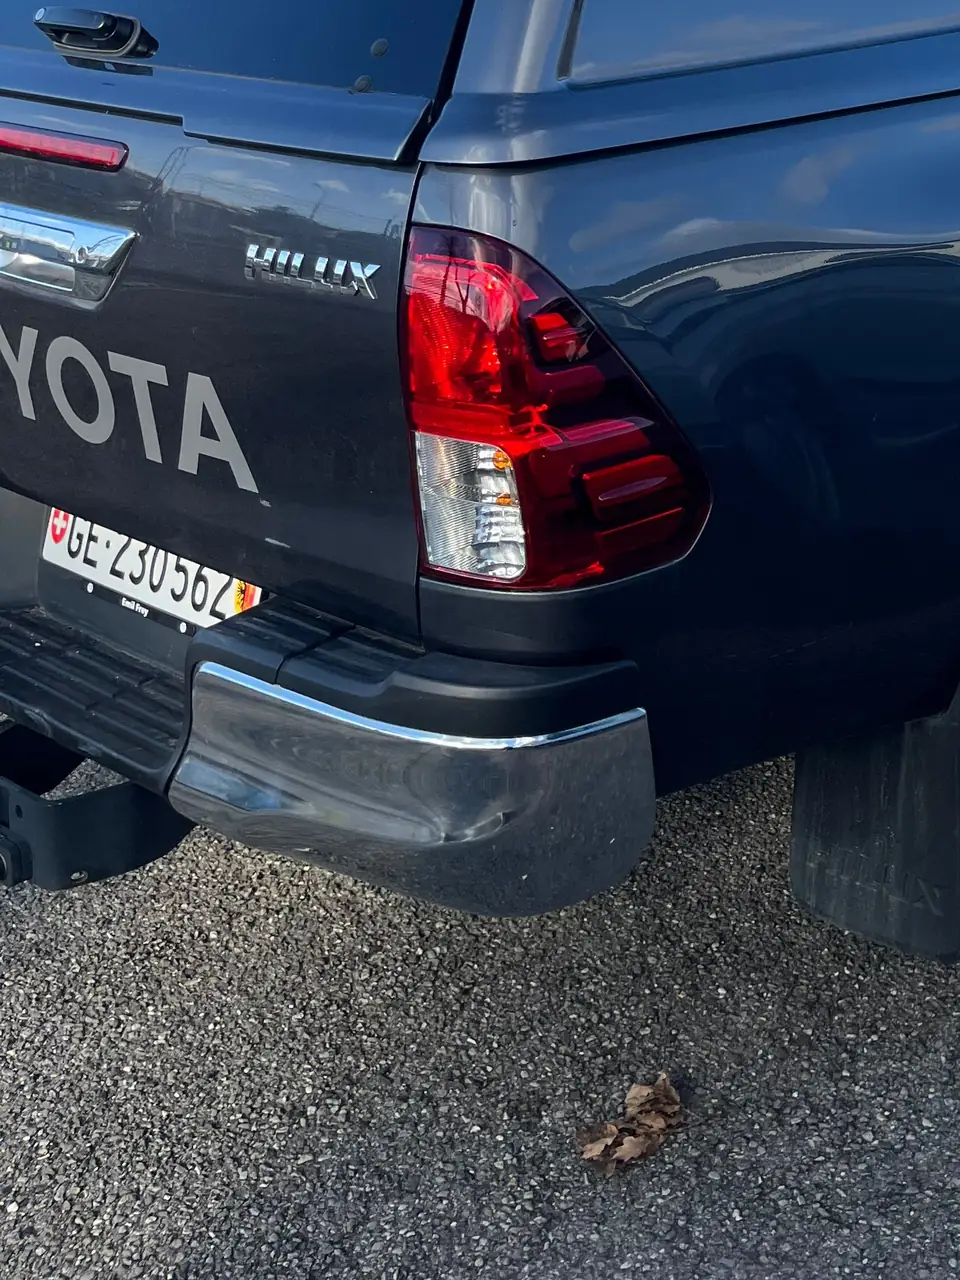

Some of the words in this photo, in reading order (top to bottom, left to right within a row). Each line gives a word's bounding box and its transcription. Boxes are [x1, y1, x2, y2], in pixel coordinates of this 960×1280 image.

[245, 244, 380, 299] HILUX
[122, 597, 136, 610] Emil
[135, 603, 149, 618] Frey
